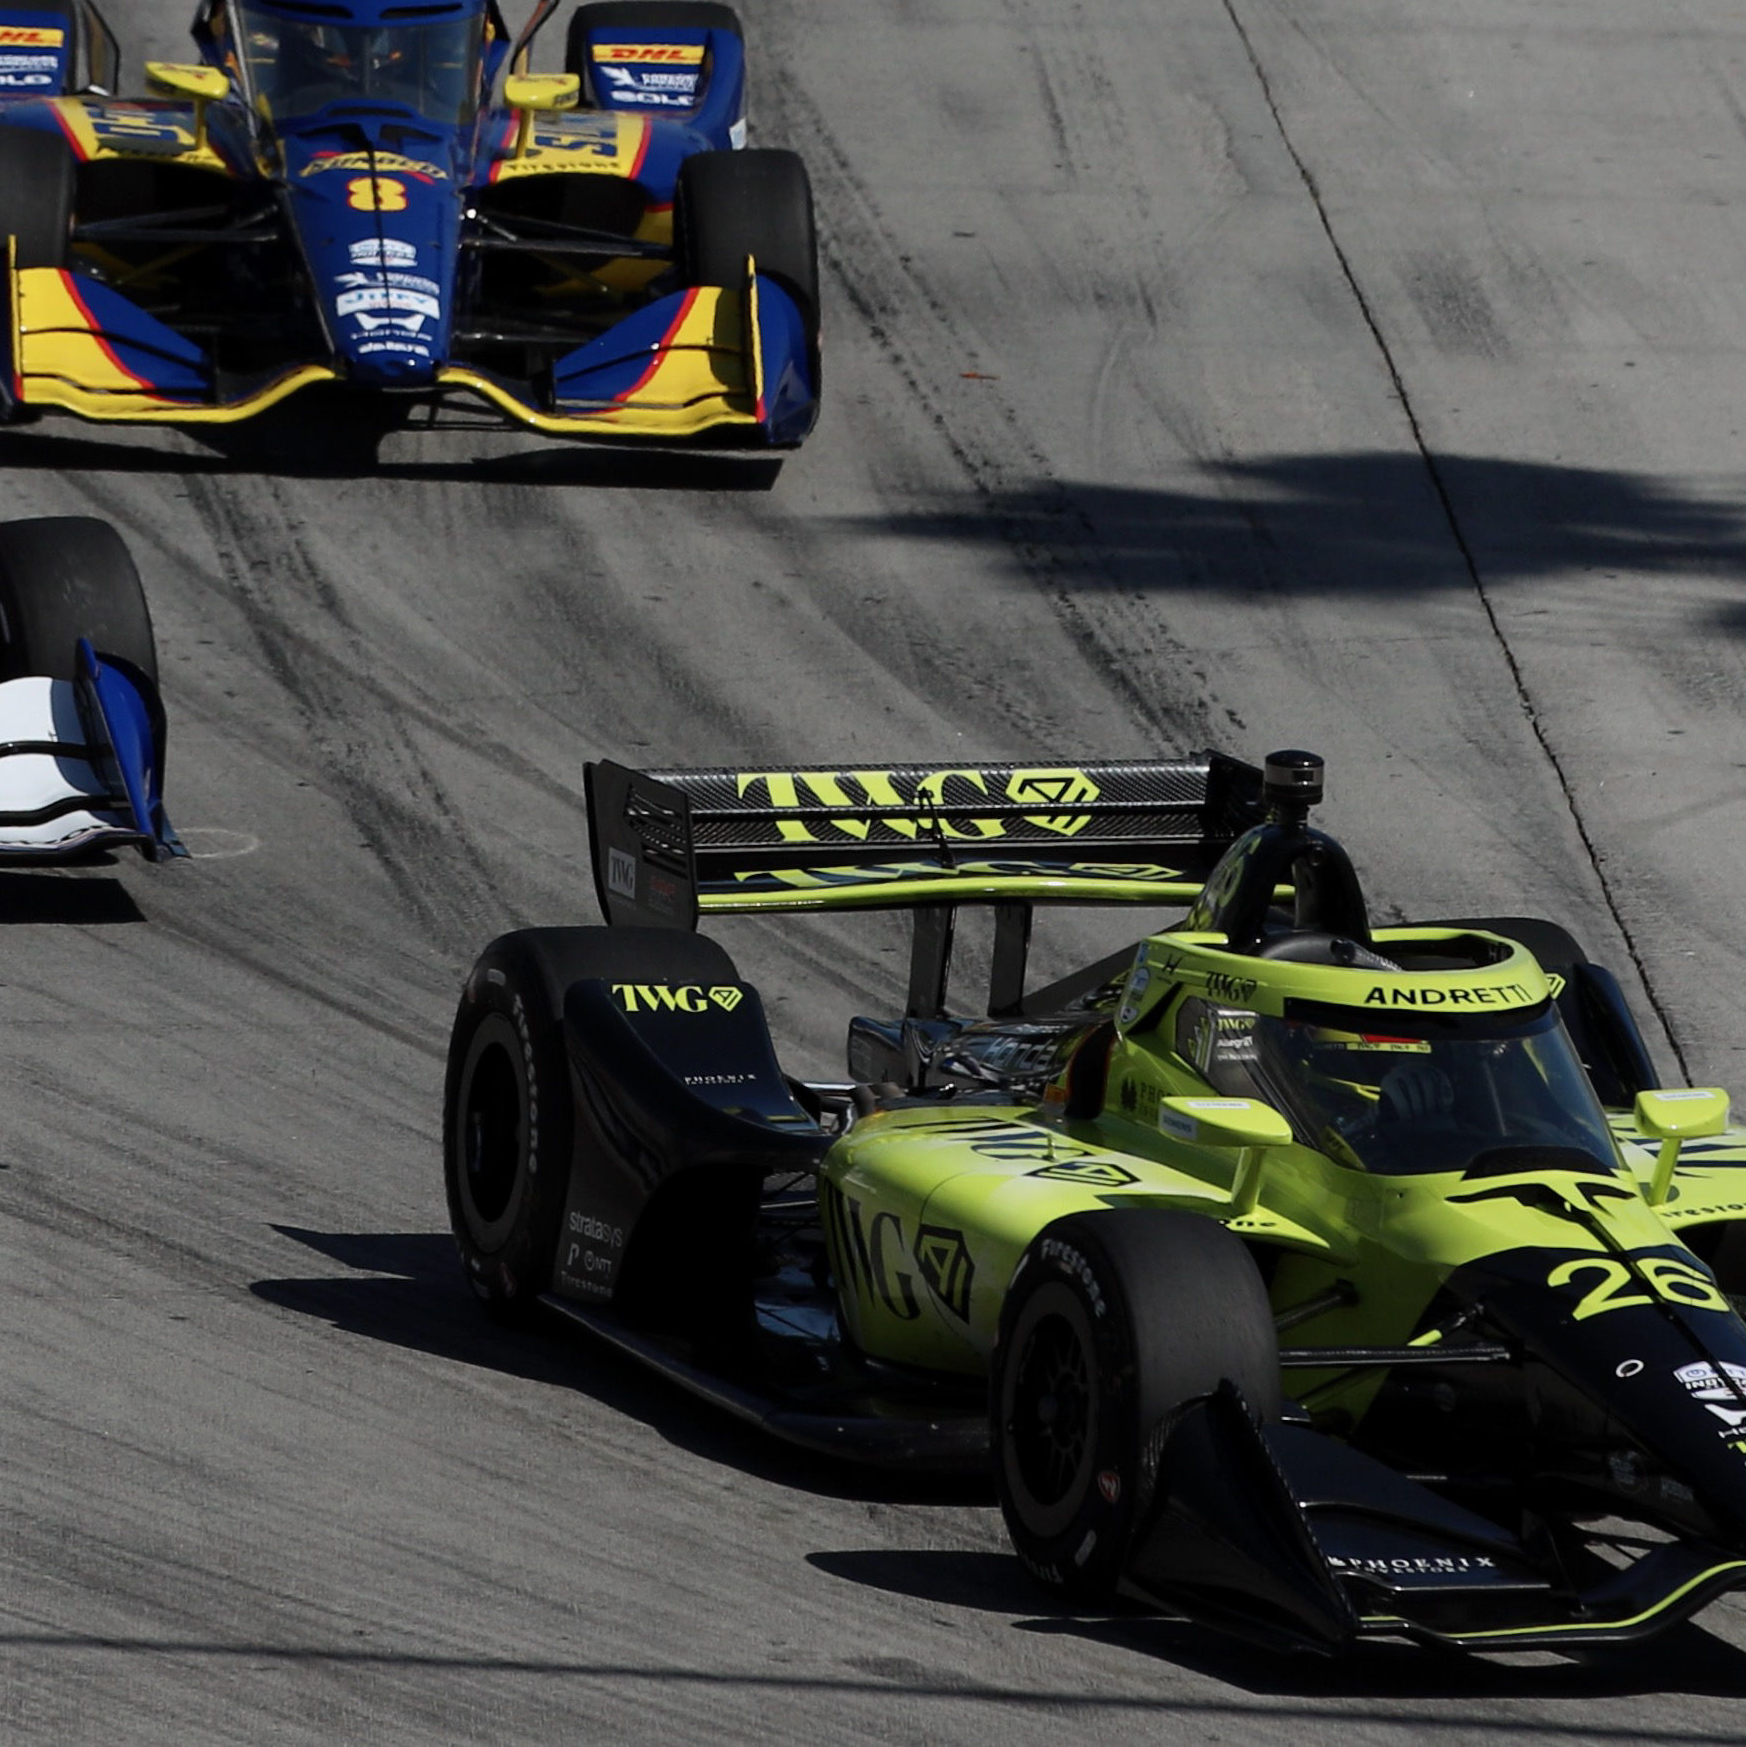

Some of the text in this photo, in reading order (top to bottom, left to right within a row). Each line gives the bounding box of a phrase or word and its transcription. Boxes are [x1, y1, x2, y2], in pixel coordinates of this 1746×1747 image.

[611, 48, 689, 61] DHL
[345, 175, 409, 213] 8
[737, 771, 1010, 843] TWG
[612, 984, 710, 1014] TWG
[1364, 984, 1534, 1006] ANDRETTI
[568, 1210, 623, 1249] stratasys
[1546, 1256, 1731, 1321] 26
[1349, 1556, 1496, 1571] PHOENIX
